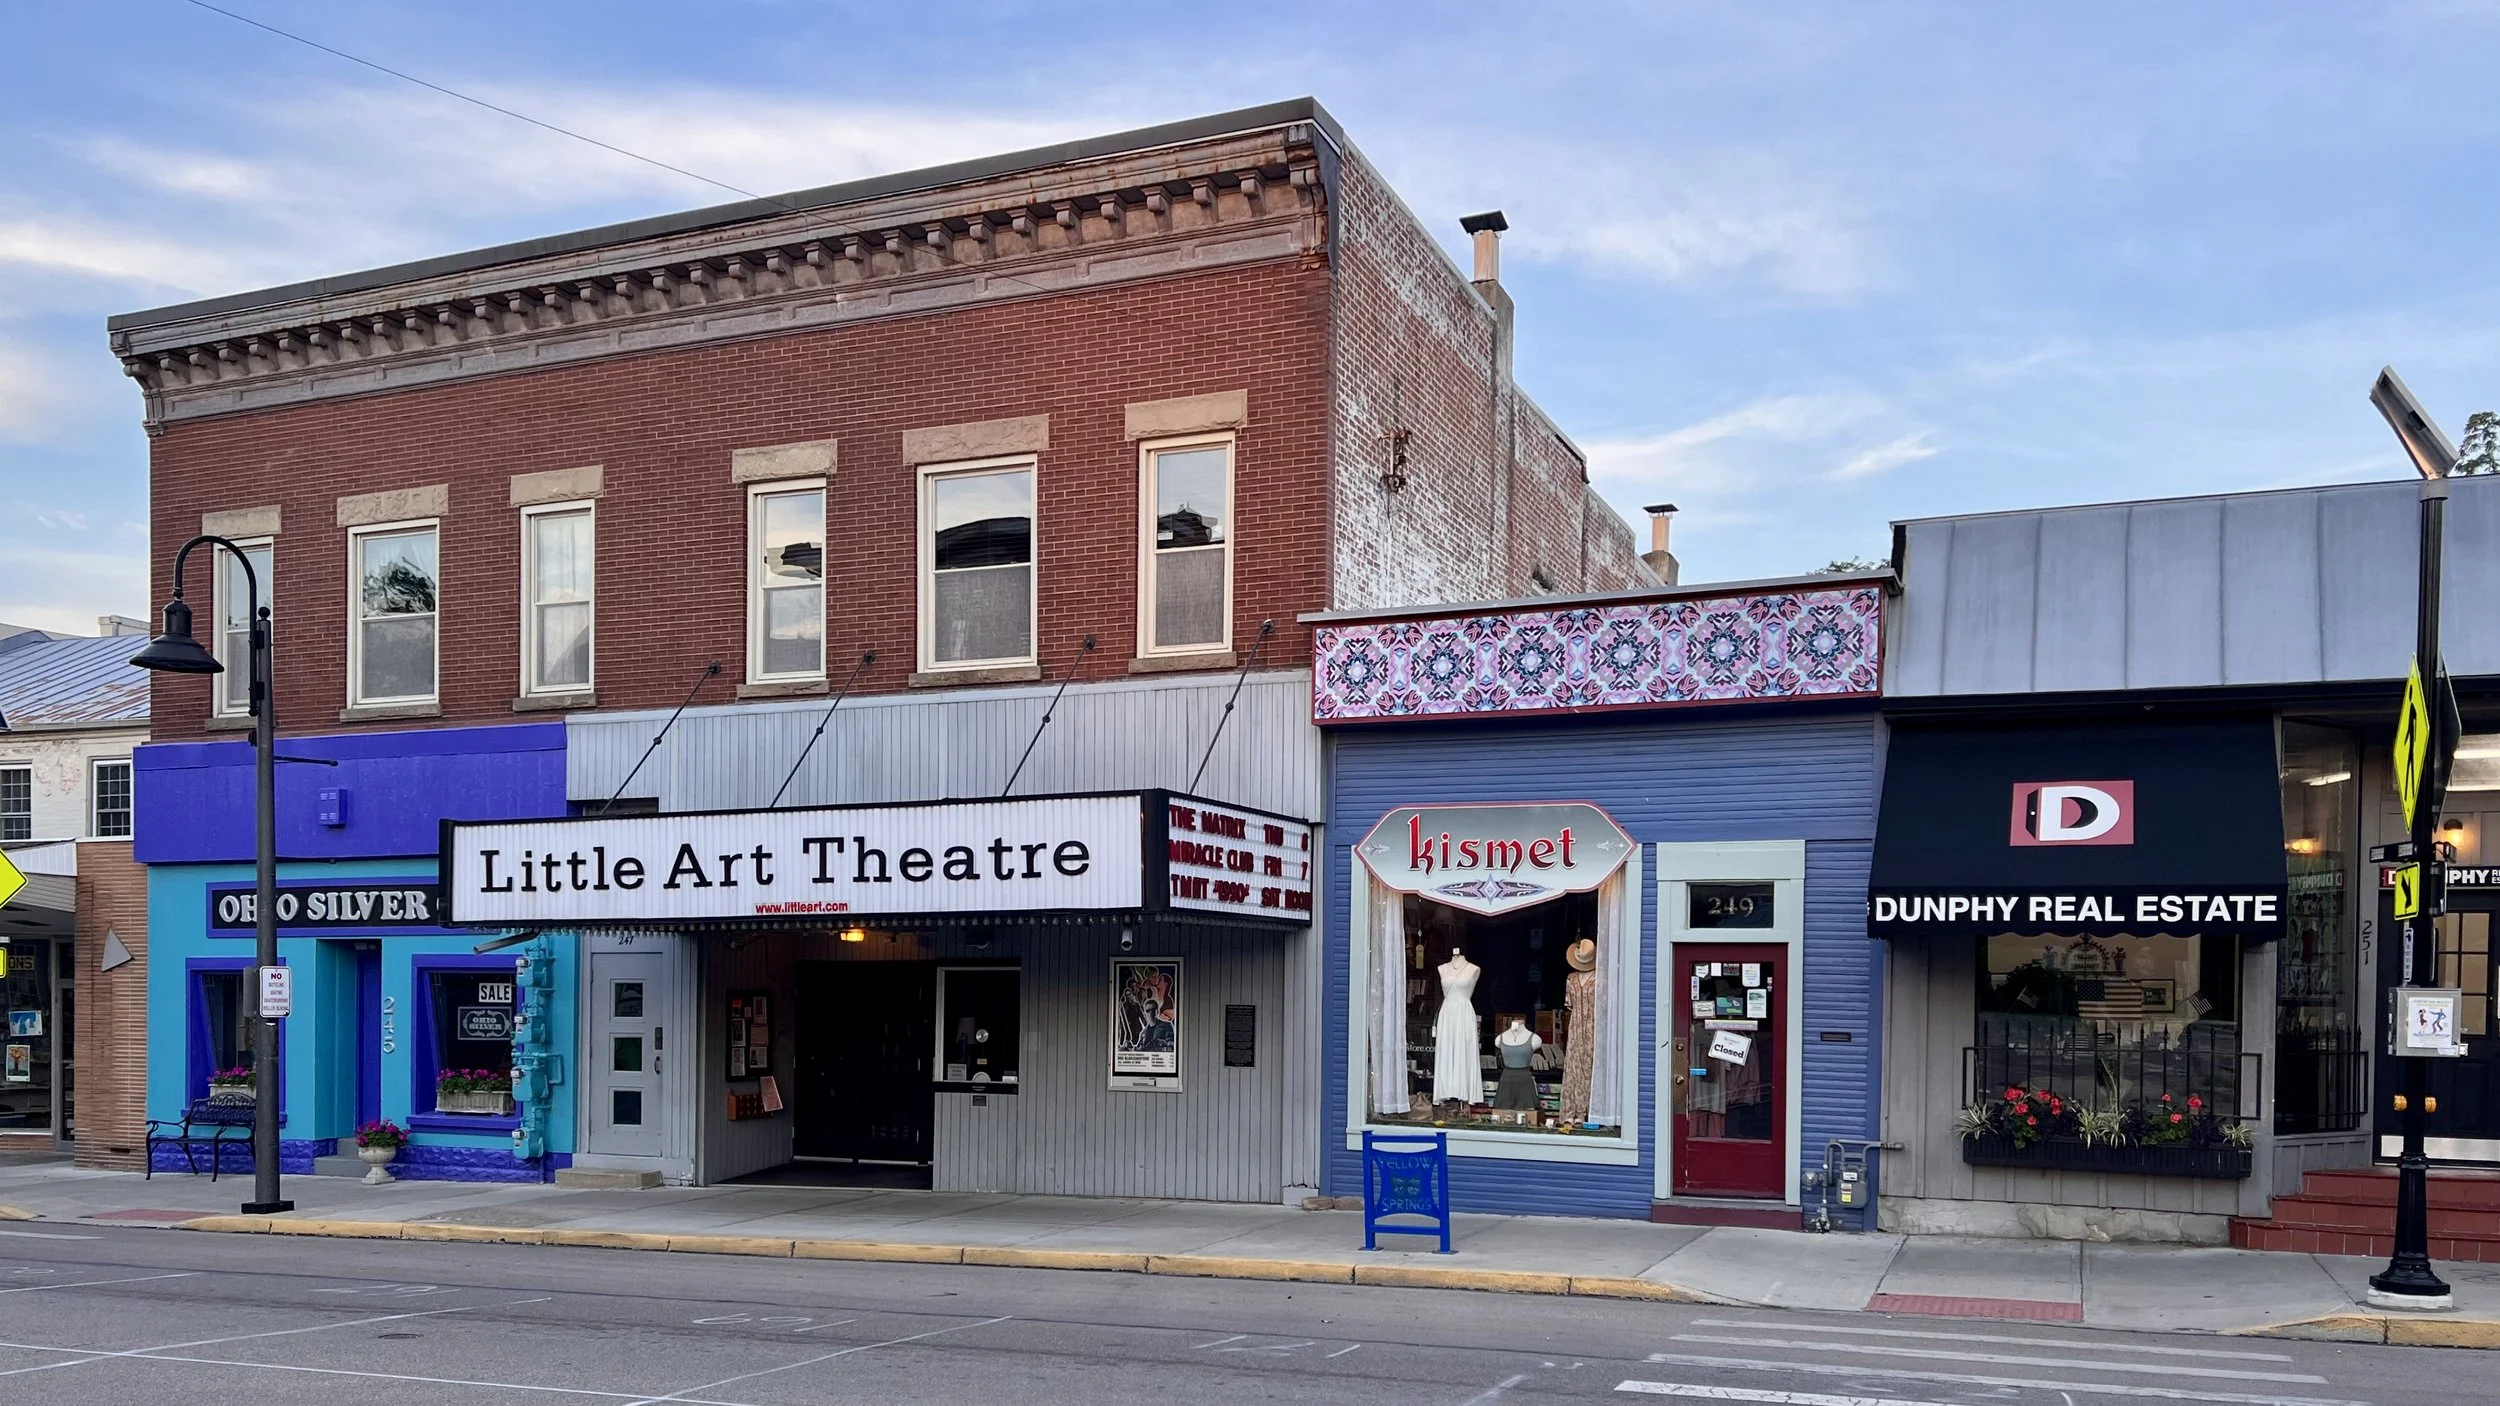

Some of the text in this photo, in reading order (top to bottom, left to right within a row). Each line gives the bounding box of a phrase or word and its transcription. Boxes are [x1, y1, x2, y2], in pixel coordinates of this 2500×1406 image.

[1169, 804, 1196, 831] THE
[1201, 811, 1247, 840] MATRIX
[1263, 823, 1284, 846] THU
[1407, 813, 1578, 878] kismet
[479, 836, 1091, 894] Little Art Theatre
[1168, 839, 1224, 869] MIRACLE
[1226, 849, 1254, 873] CLUB
[1263, 855, 1282, 878] FRI
[218, 893, 300, 923] OHO
[306, 890, 431, 921] SILVER
[755, 901, 849, 914] www.littleart.com
[1261, 886, 1282, 908] SAT
[1284, 888, 1312, 911] NOON
[1707, 895, 1755, 918] 249
[1874, 896, 2019, 923] DUNPHY
[2028, 895, 2125, 923] REAL
[2136, 895, 2278, 923] ESTATE
[2361, 920, 2373, 966] 251
[270, 972, 283, 980] NO
[480, 984, 511, 1001] SALE
[383, 996, 396, 1054] 245
[468, 1023, 503, 1031] SILVER
[472, 1016, 497, 1024] OHIO
[1713, 1043, 1745, 1059] Closed
[1377, 1155, 1433, 1169] YELLOW
[1381, 1198, 1433, 1212] SPRINGS
